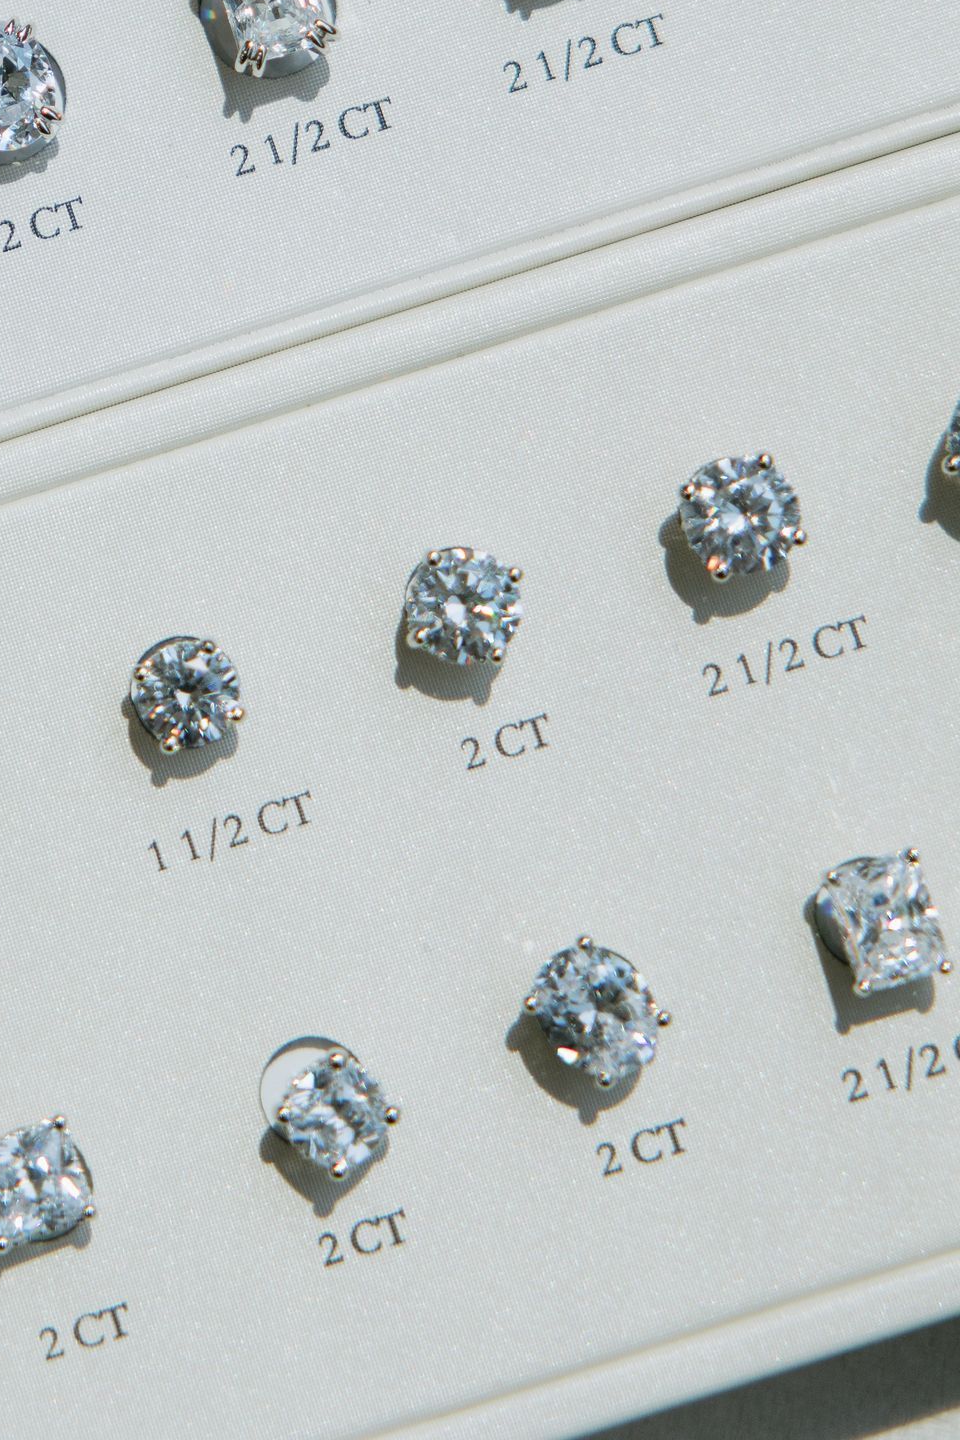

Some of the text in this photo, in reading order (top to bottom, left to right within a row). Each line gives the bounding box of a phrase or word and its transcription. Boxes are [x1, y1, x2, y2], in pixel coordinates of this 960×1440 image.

[502, 12, 665, 94] 2 1/2 CT
[230, 95, 393, 178] 2 1/2 CT
[29, 194, 84, 241] CT
[702, 613, 868, 698] 2 1/2 CT
[460, 712, 550, 772] 2 CT
[147, 789, 312, 873] 1 1/2 CT
[841, 1067, 870, 1104] 2
[876, 1042, 948, 1093] 1/2
[596, 1116, 687, 1179] 2 CT
[317, 1206, 407, 1269] 2 CT
[38, 1301, 129, 1362] 2 CT
